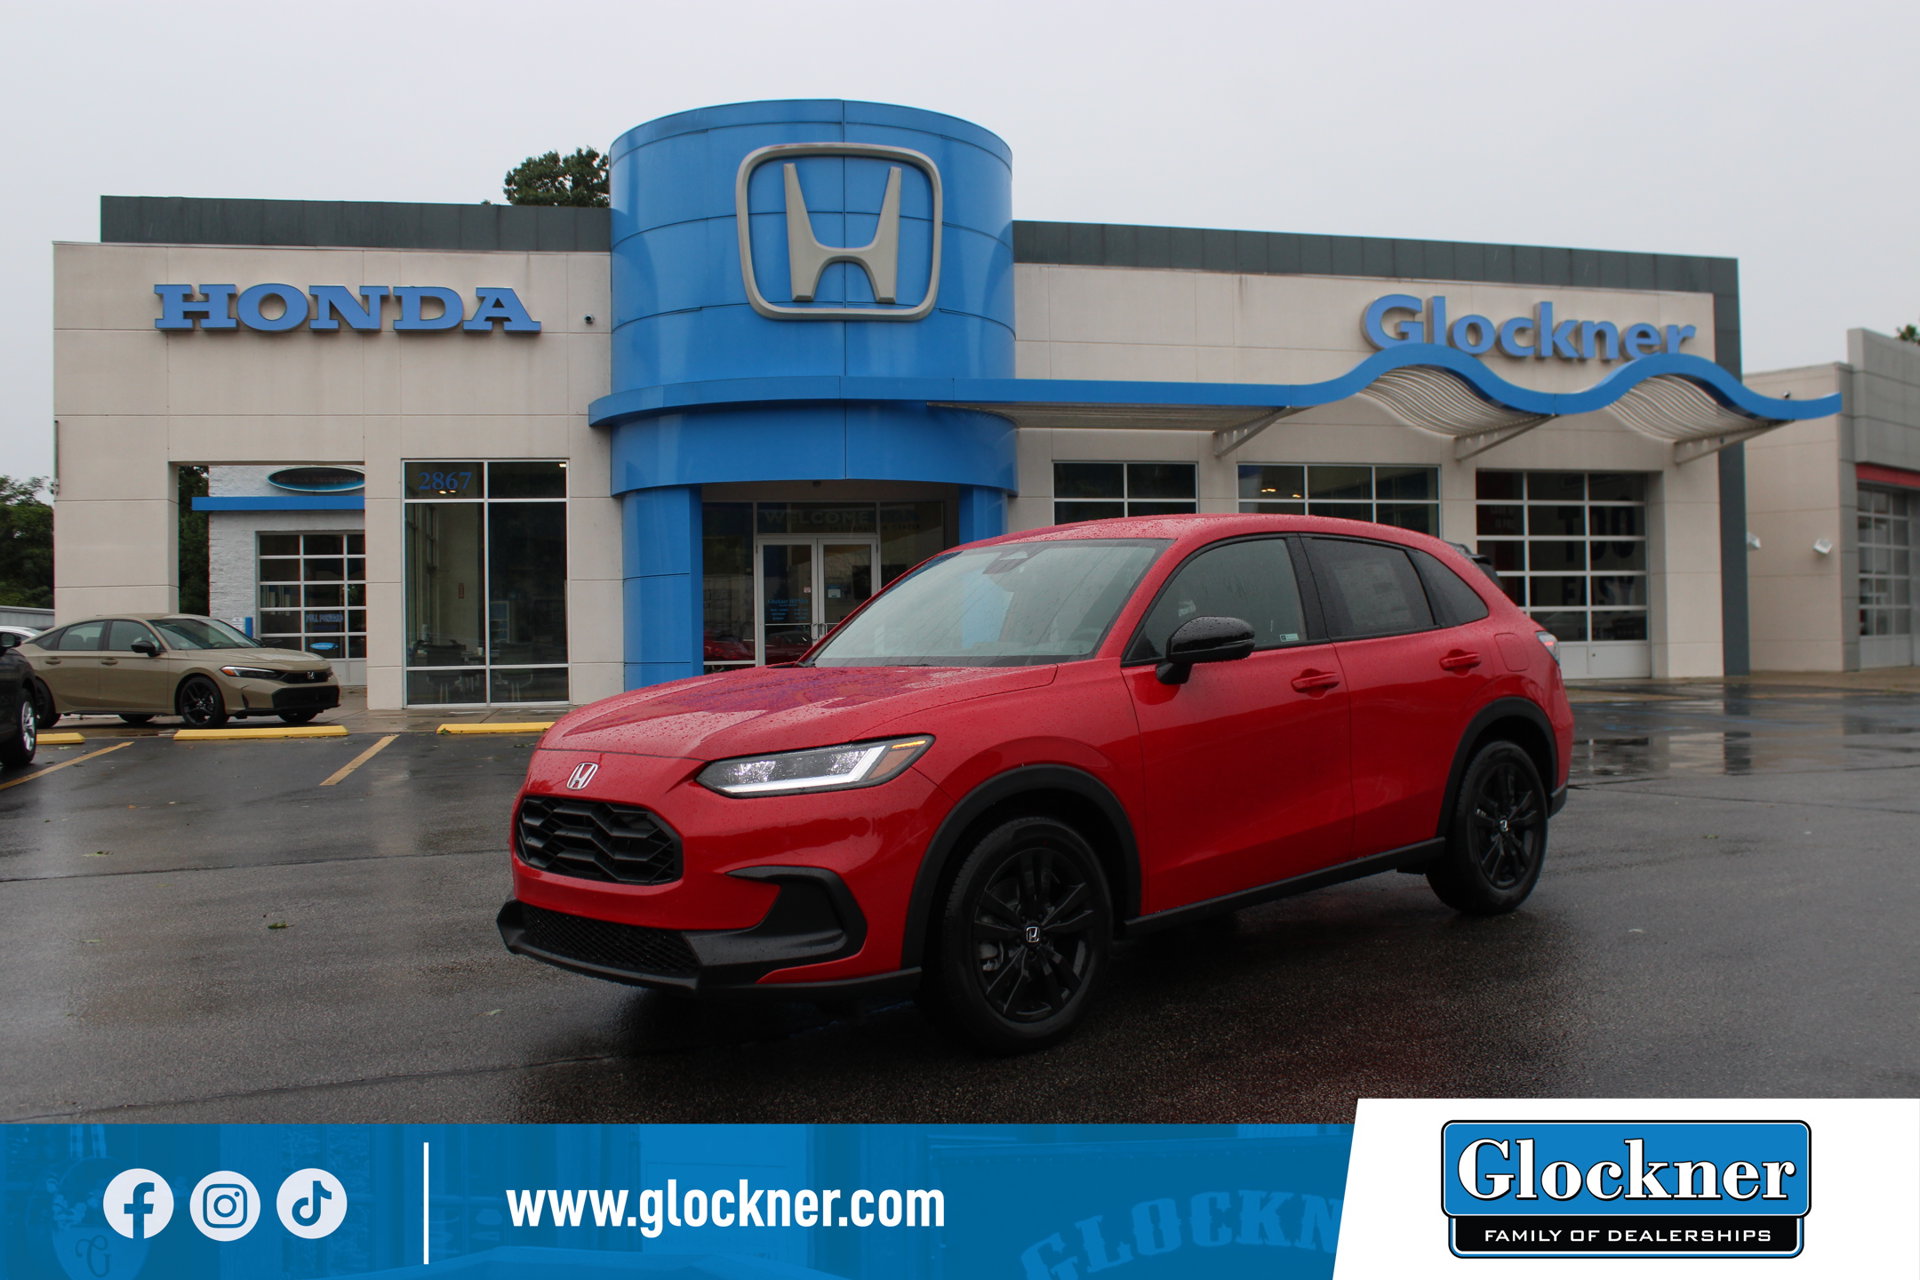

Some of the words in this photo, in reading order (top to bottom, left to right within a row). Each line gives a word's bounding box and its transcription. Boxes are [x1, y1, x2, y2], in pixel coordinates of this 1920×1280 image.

[154, 283, 541, 332] HONDA
[1361, 293, 1696, 360] Glockner
[418, 472, 472, 490] 2867
[764, 511, 869, 525] WELCOME
